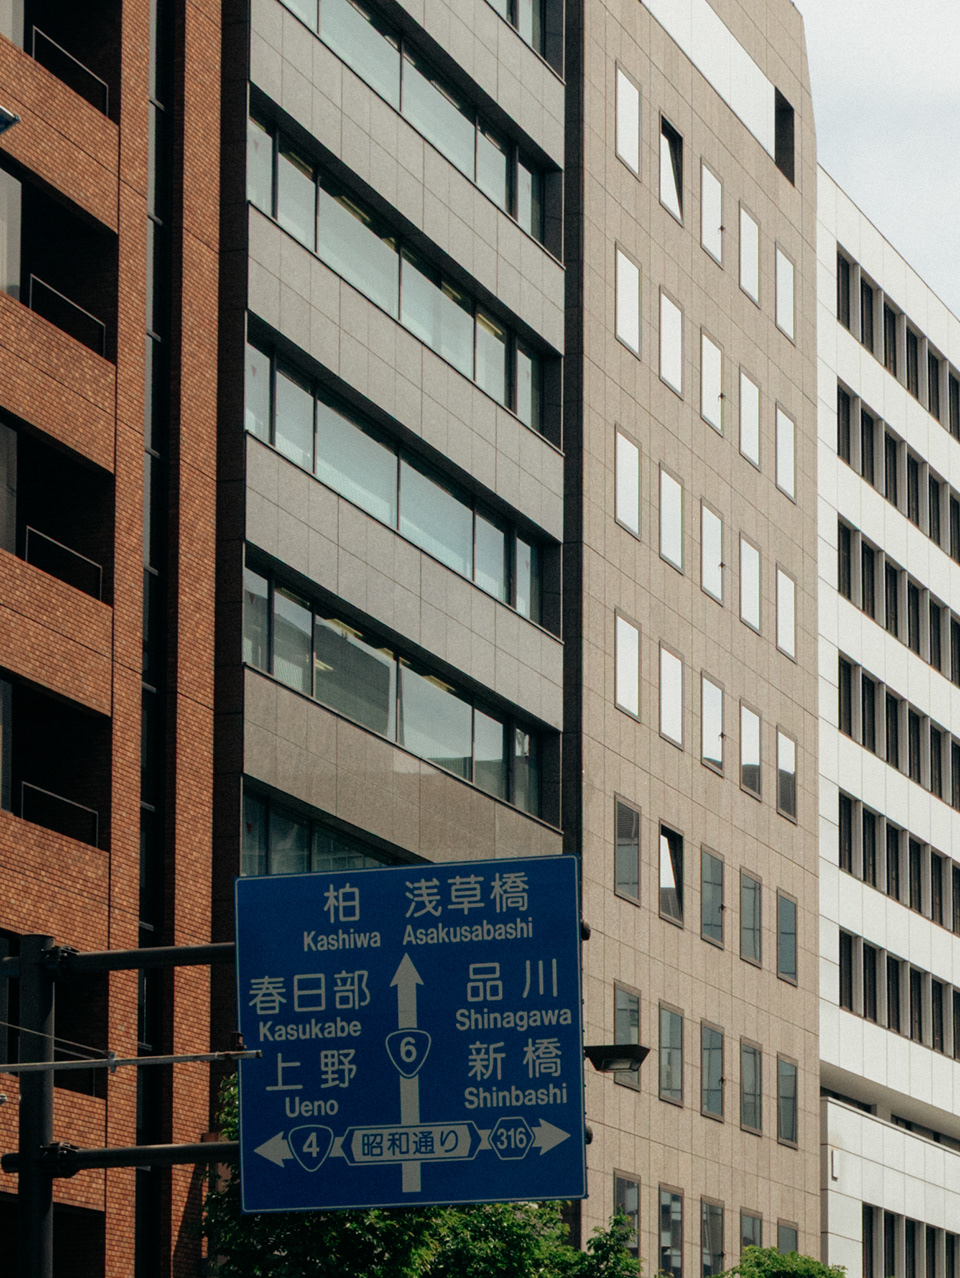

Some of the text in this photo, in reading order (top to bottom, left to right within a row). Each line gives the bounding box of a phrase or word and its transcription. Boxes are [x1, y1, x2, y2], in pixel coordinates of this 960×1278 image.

[323, 883, 360, 923] 柏
[405, 872, 529, 918] 浅草橋
[303, 930, 381, 952] Kashiwa
[402, 917, 533, 946] Asakusabashi
[248, 969, 371, 1015] 春日部
[466, 958, 558, 1002] 品川
[259, 1017, 362, 1042] Kasukabe
[455, 1008, 572, 1032] Shinagawa
[399, 1036, 417, 1063] 6
[467, 1037, 562, 1081] 新橋
[266, 1049, 357, 1091] 上野
[285, 1097, 339, 1118] Ueno
[464, 1083, 567, 1109] Shinbashi
[302, 1132, 319, 1158] 4
[361, 1130, 460, 1157] 昭和通り
[496, 1127, 526, 1150] 316
